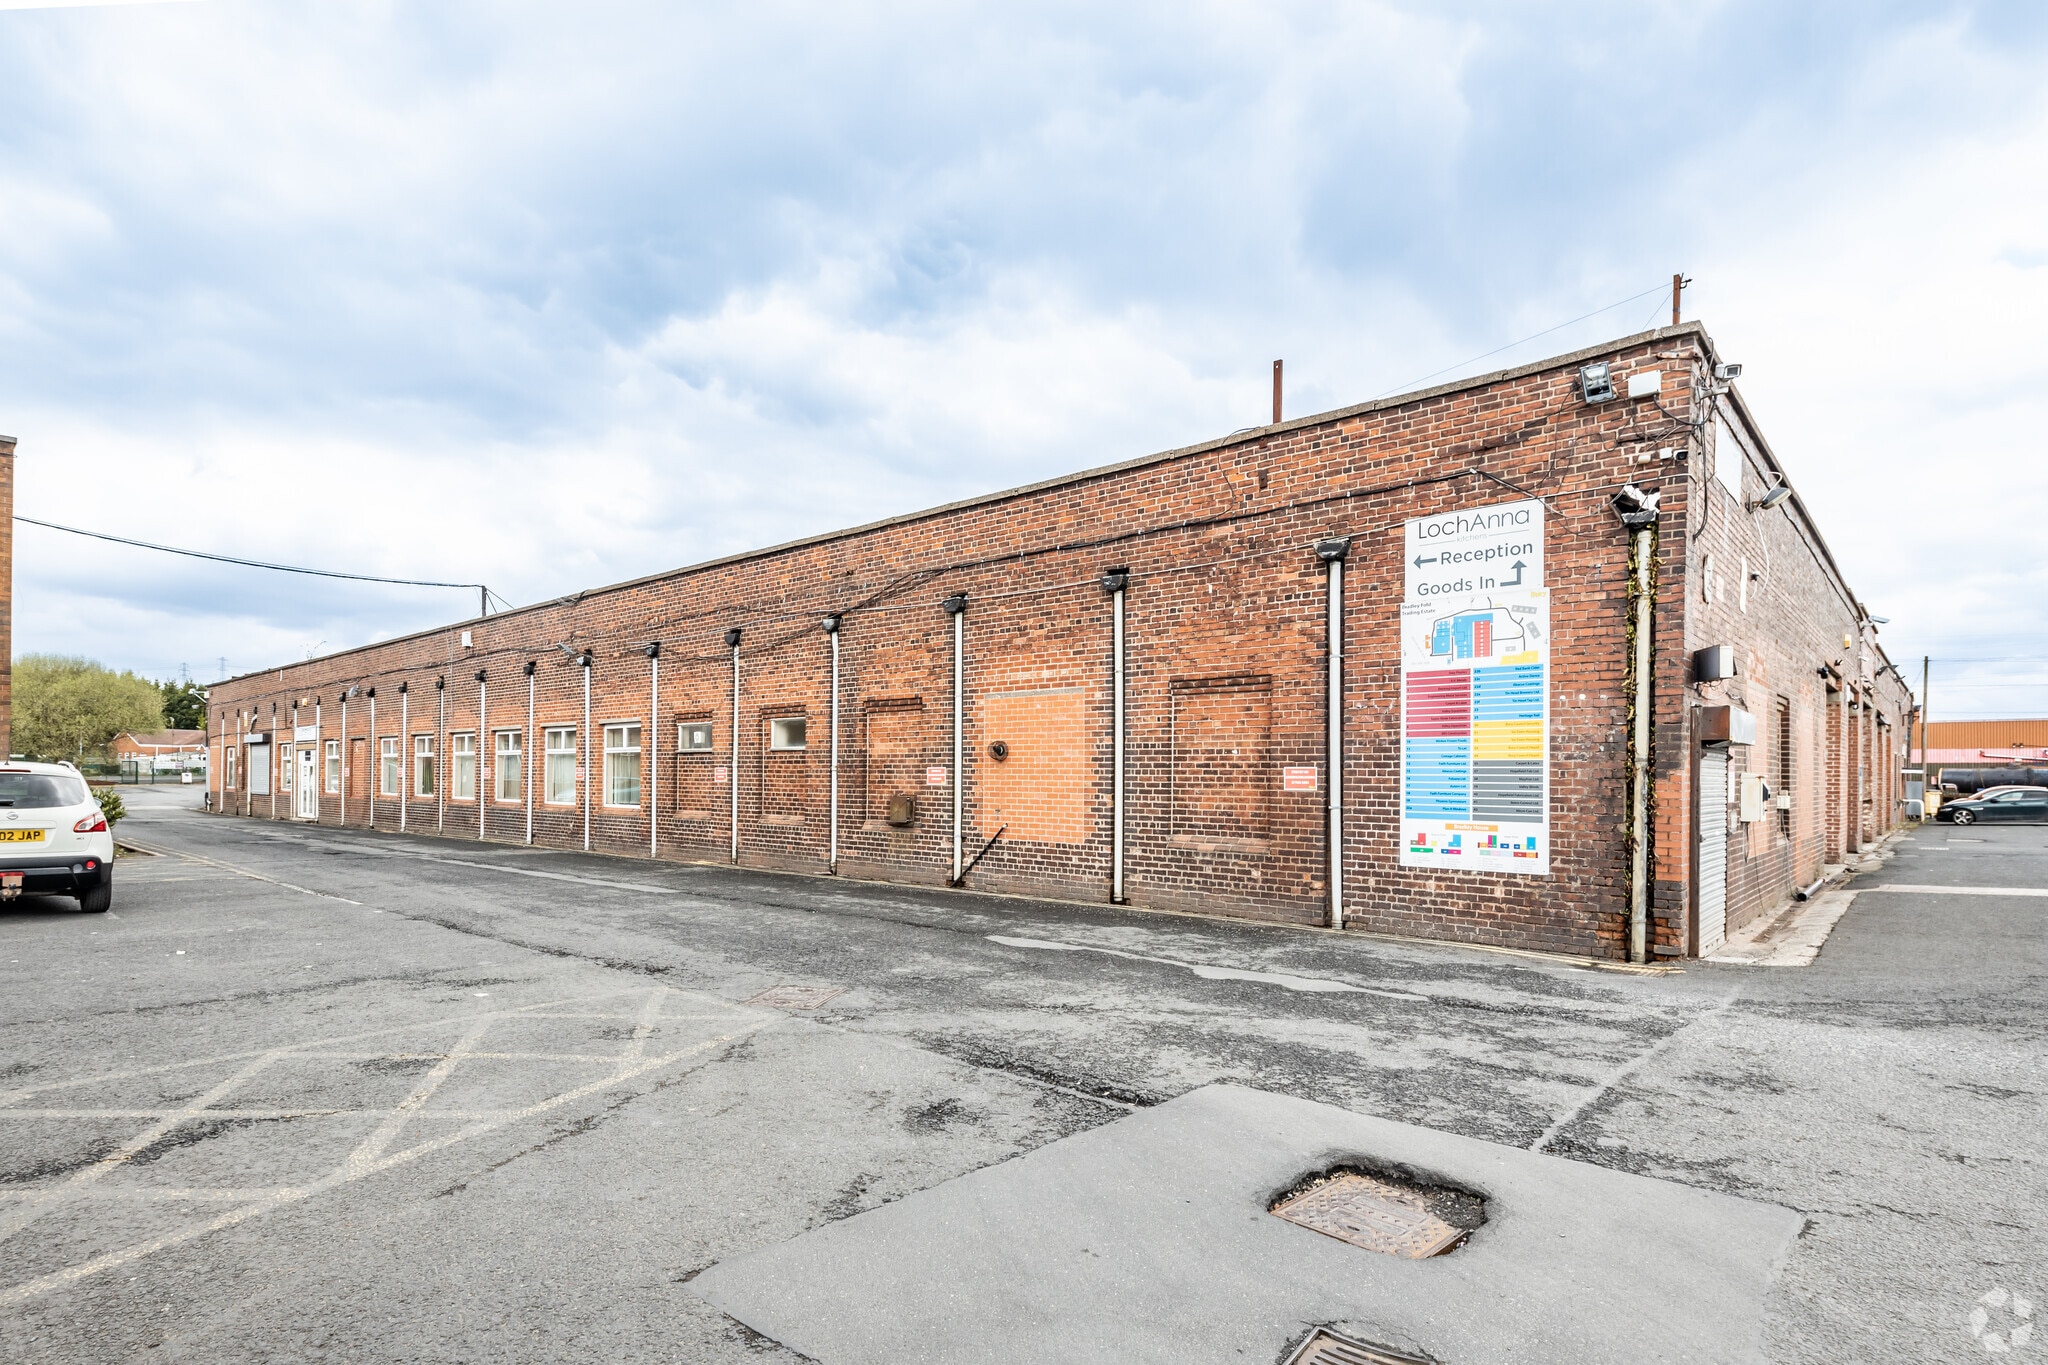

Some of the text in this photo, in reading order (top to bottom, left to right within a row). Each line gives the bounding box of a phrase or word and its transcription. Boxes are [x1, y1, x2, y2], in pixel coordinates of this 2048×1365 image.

[1418, 509, 1530, 539] LochAnna
[1456, 533, 1488, 543] kitchens
[1440, 543, 1533, 565] Reception
[1418, 576, 1495, 596] Goods In
[18, 831, 41, 841] JAP
